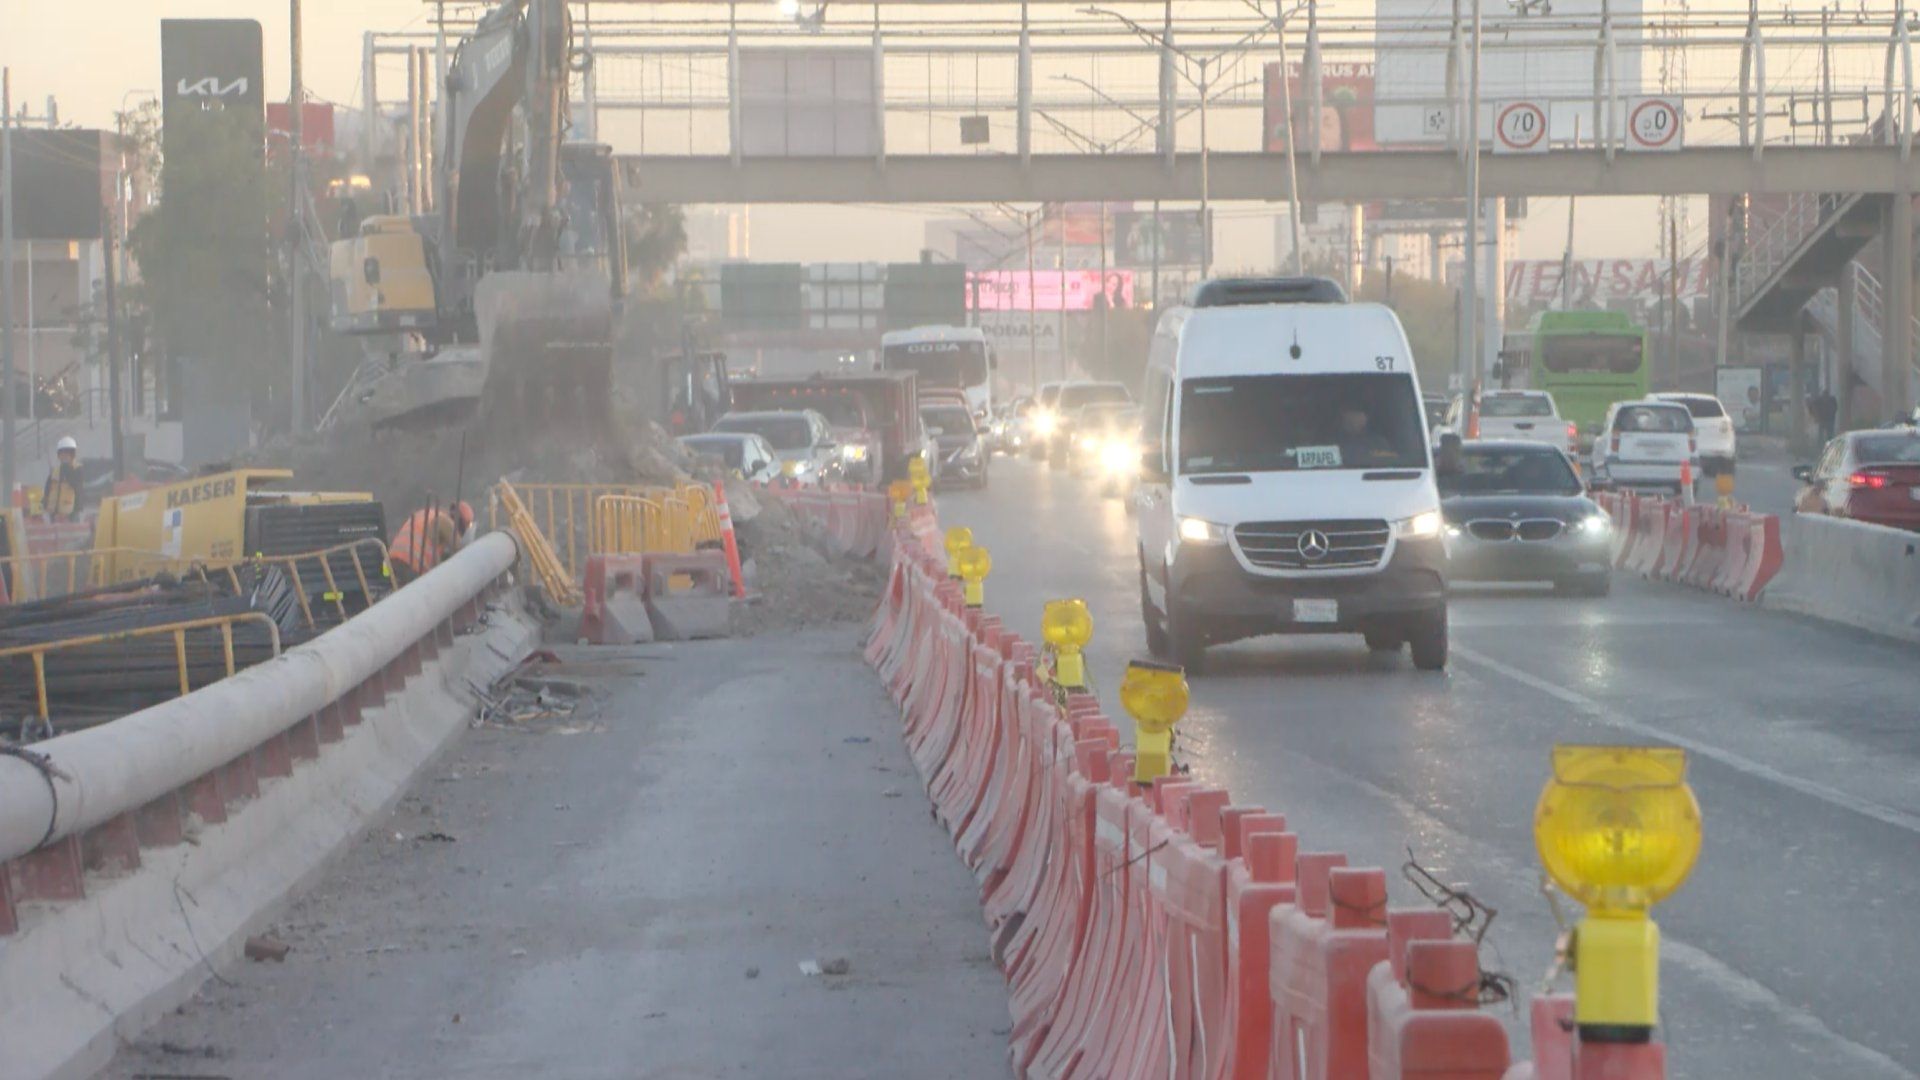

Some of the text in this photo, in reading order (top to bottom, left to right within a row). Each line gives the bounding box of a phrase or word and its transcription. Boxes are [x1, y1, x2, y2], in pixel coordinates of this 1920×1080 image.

[177, 76, 248, 95] KIA
[1511, 112, 1534, 132] 70
[1375, 356, 1394, 370] 87
[166, 477, 236, 509] KAESER
